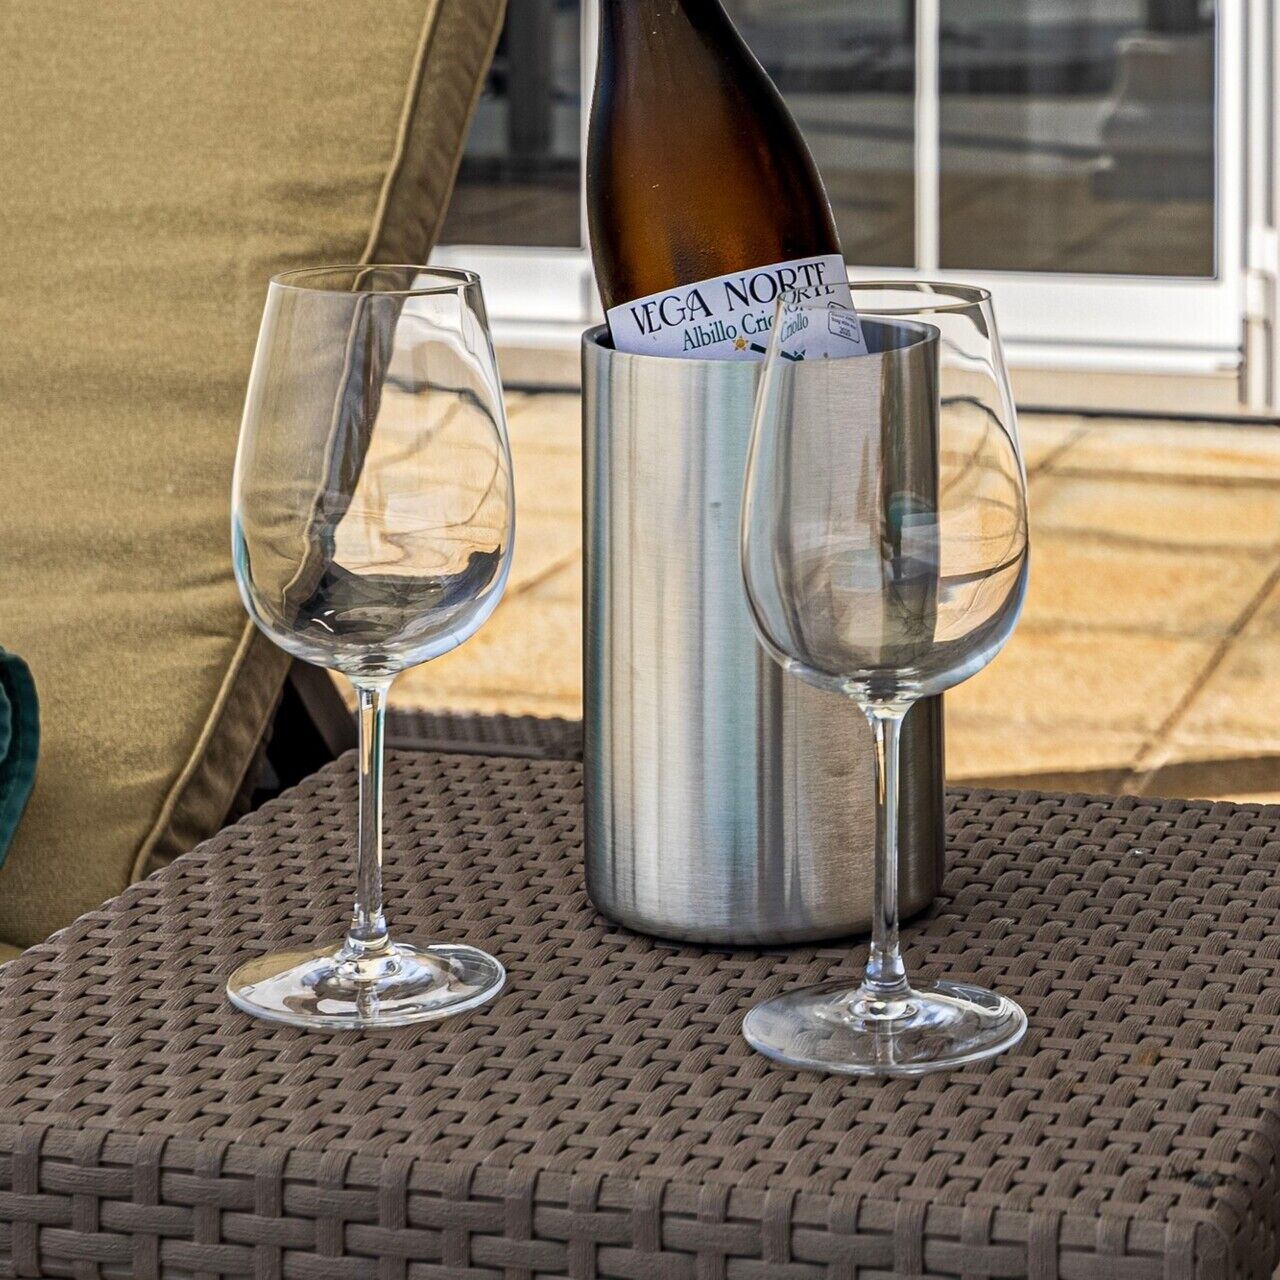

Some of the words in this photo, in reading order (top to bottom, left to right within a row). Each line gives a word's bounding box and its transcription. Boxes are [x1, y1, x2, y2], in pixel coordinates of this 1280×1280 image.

[630, 288, 714, 335] VEGA
[723, 261, 826, 312] NORTE
[682, 320, 738, 351] Albillo
